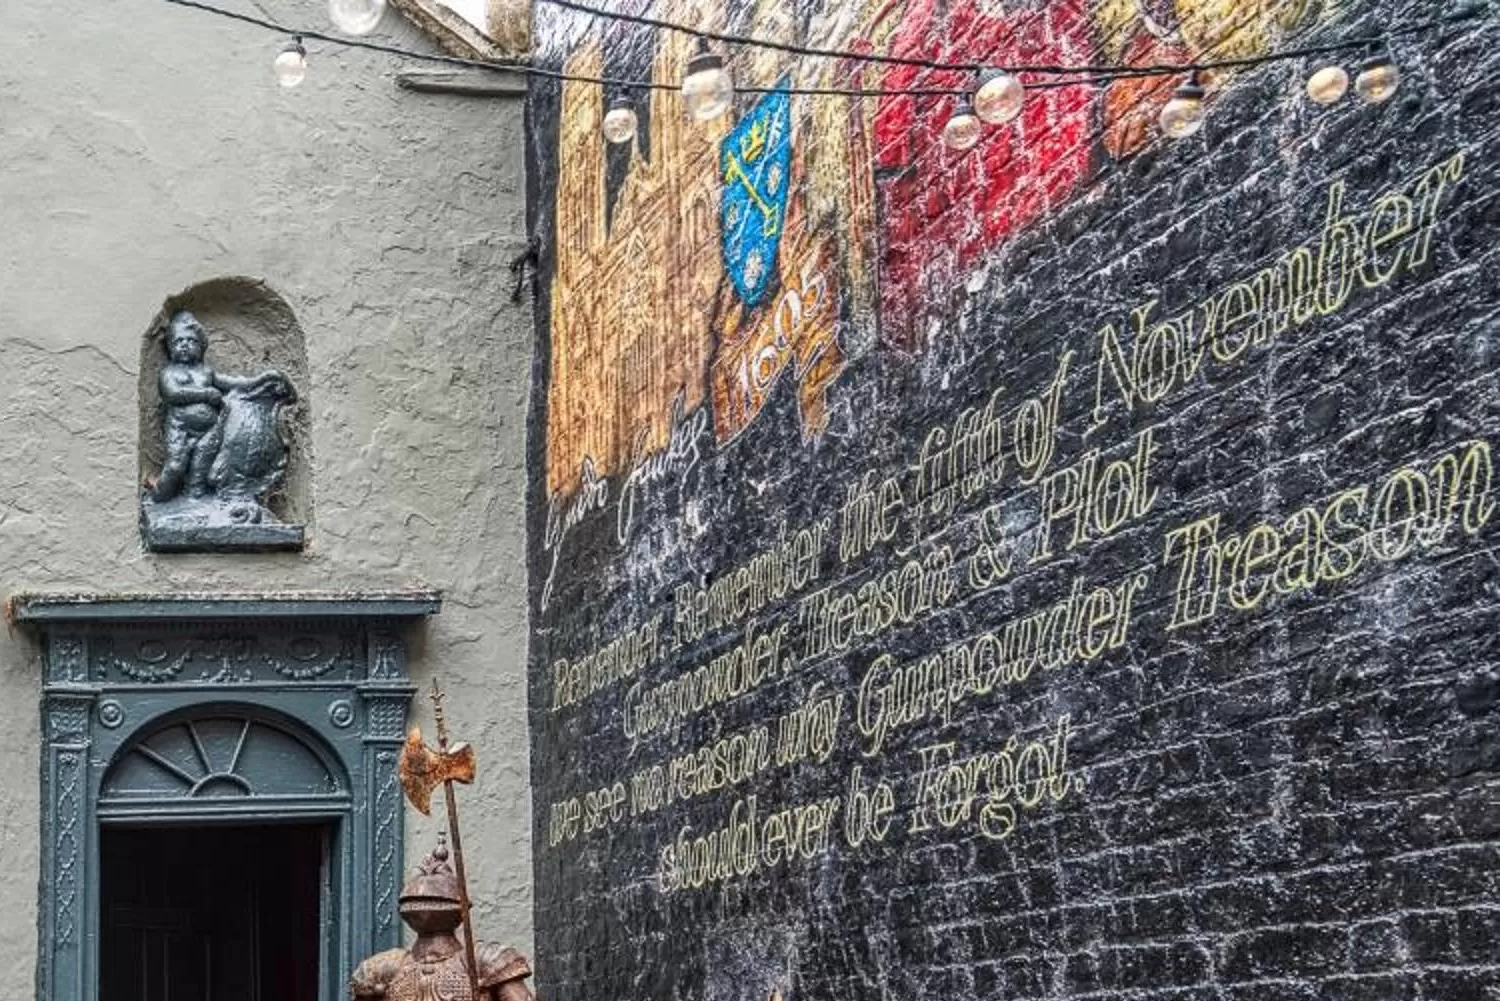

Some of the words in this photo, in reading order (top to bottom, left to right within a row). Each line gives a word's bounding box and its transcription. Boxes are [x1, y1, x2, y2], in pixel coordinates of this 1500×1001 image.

[838, 468, 904, 562] the
[1014, 350, 1076, 486] of
[1090, 152, 1465, 426] November
[583, 781, 626, 834] see
[666, 725, 771, 802] reason
[776, 680, 843, 763] why
[857, 573, 1148, 757] Gunpowder
[1164, 439, 1492, 630] Treason
[799, 545, 956, 664] Treason
[969, 501, 1012, 590] &
[1026, 428, 1158, 565] Plot
[658, 794, 757, 893] should
[761, 796, 840, 867] ever
[846, 765, 895, 847] be
[908, 713, 1086, 839] Forgot.
